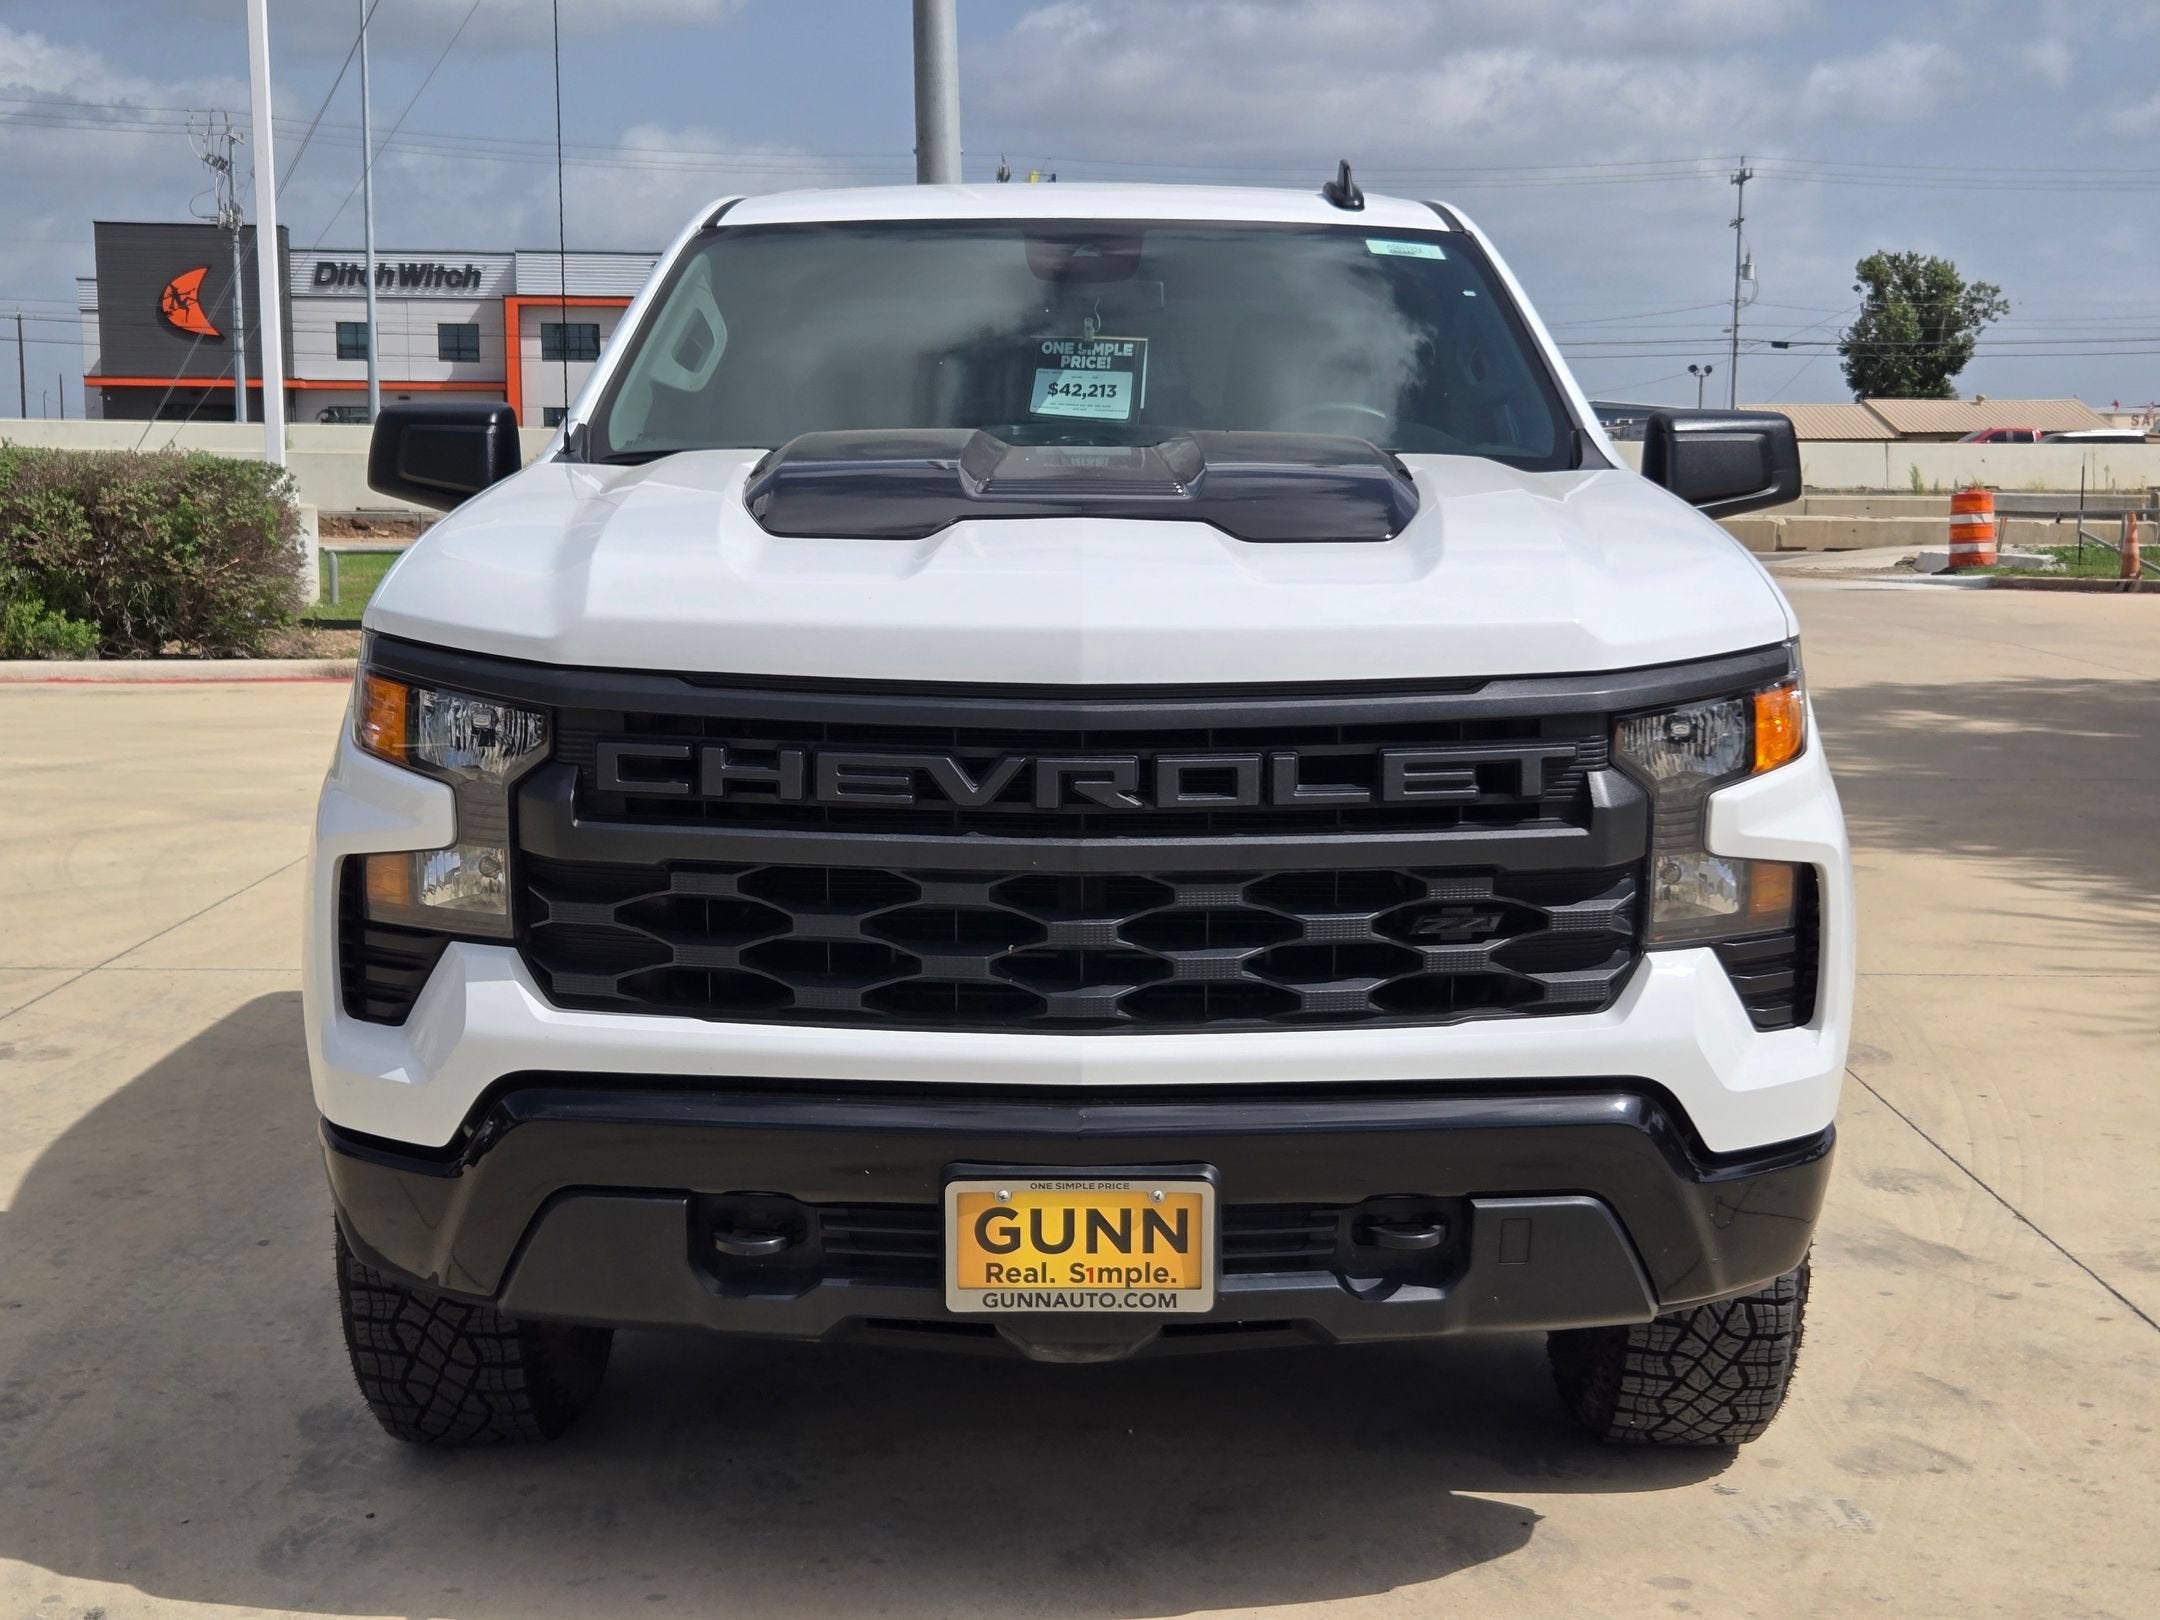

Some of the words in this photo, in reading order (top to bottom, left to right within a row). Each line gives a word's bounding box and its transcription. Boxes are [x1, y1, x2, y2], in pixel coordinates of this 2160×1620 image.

[398, 262, 482, 289] Witch
[1041, 341, 1074, 355] ONE
[1060, 355, 1112, 369] PRICE!
[1047, 381, 1118, 400] $42,213
[596, 742, 1577, 808] CHEVROLET
[1029, 1182, 1054, 1191] ONE
[1055, 1182, 1097, 1191] SIMPLE
[1098, 1182, 1130, 1191] PRICE
[974, 1207, 1189, 1255] GUNN
[985, 1262, 1056, 1284] Real.
[982, 1292, 1178, 1309] GUNNAUTO.COM
